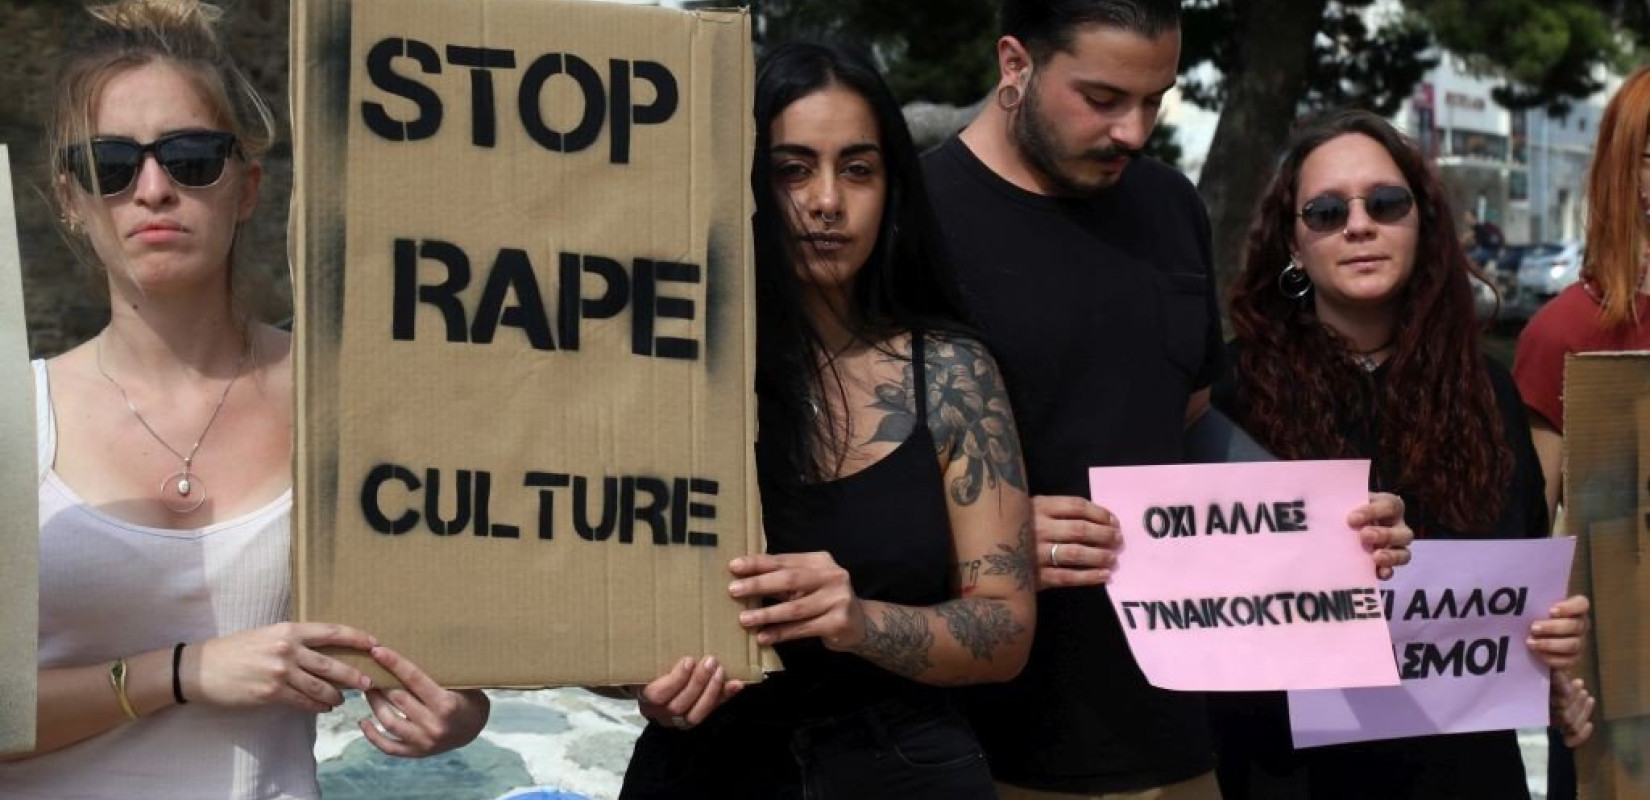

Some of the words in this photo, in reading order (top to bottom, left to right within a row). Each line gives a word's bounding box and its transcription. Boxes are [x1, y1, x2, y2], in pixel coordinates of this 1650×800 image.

[361, 37, 678, 164] STOP
[391, 238, 701, 360] RAPE
[360, 463, 719, 547] CULTURE
[1143, 504, 1197, 539] ΟΧΙ
[1205, 499, 1308, 536] ΑΛΛΕΣ
[1121, 587, 1381, 631] ΓΥΝΑΙΚΟΚΤΟΝΙΕΣ
[1403, 586, 1529, 621] ΑΛΛΟΙ
[1392, 636, 1509, 680] ΣΜΟΙ
